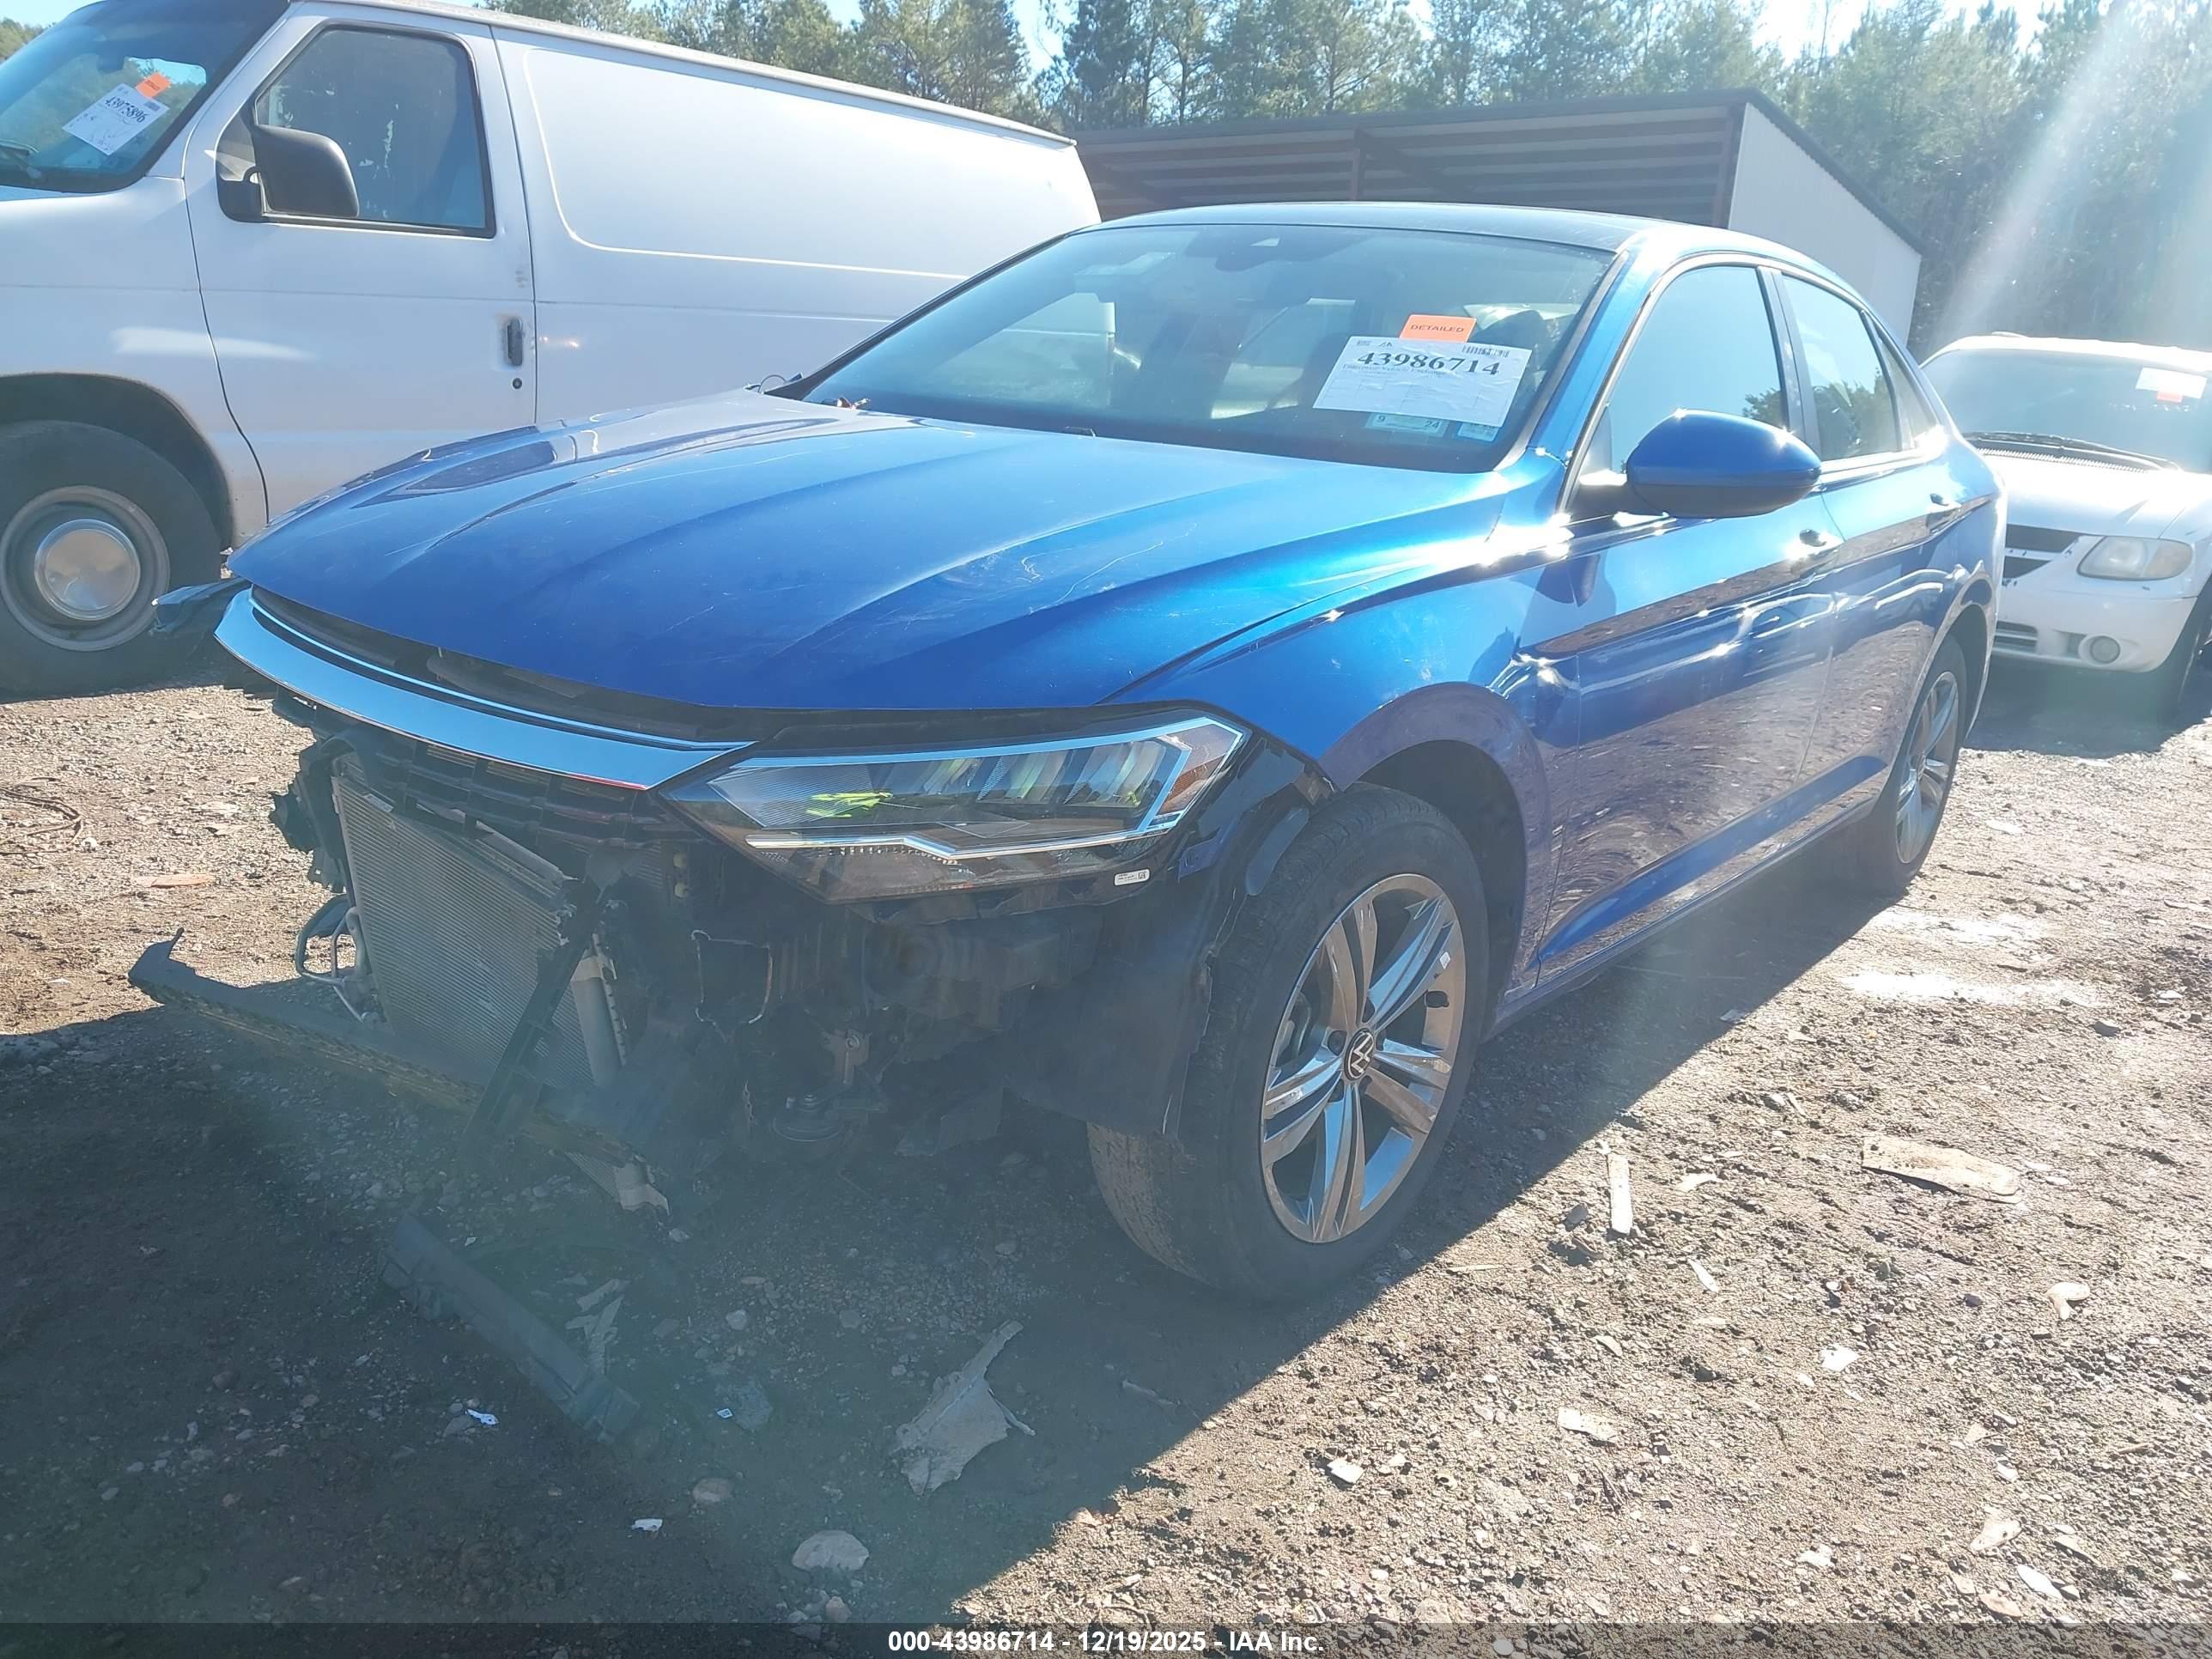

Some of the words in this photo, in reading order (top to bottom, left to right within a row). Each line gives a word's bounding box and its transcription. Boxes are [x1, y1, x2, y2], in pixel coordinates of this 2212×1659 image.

[105, 96, 146, 123] 43975896
[1410, 324, 1464, 333] DETAILED
[1356, 351, 1501, 375] 43986714
[1425, 420, 1439, 428] 24
